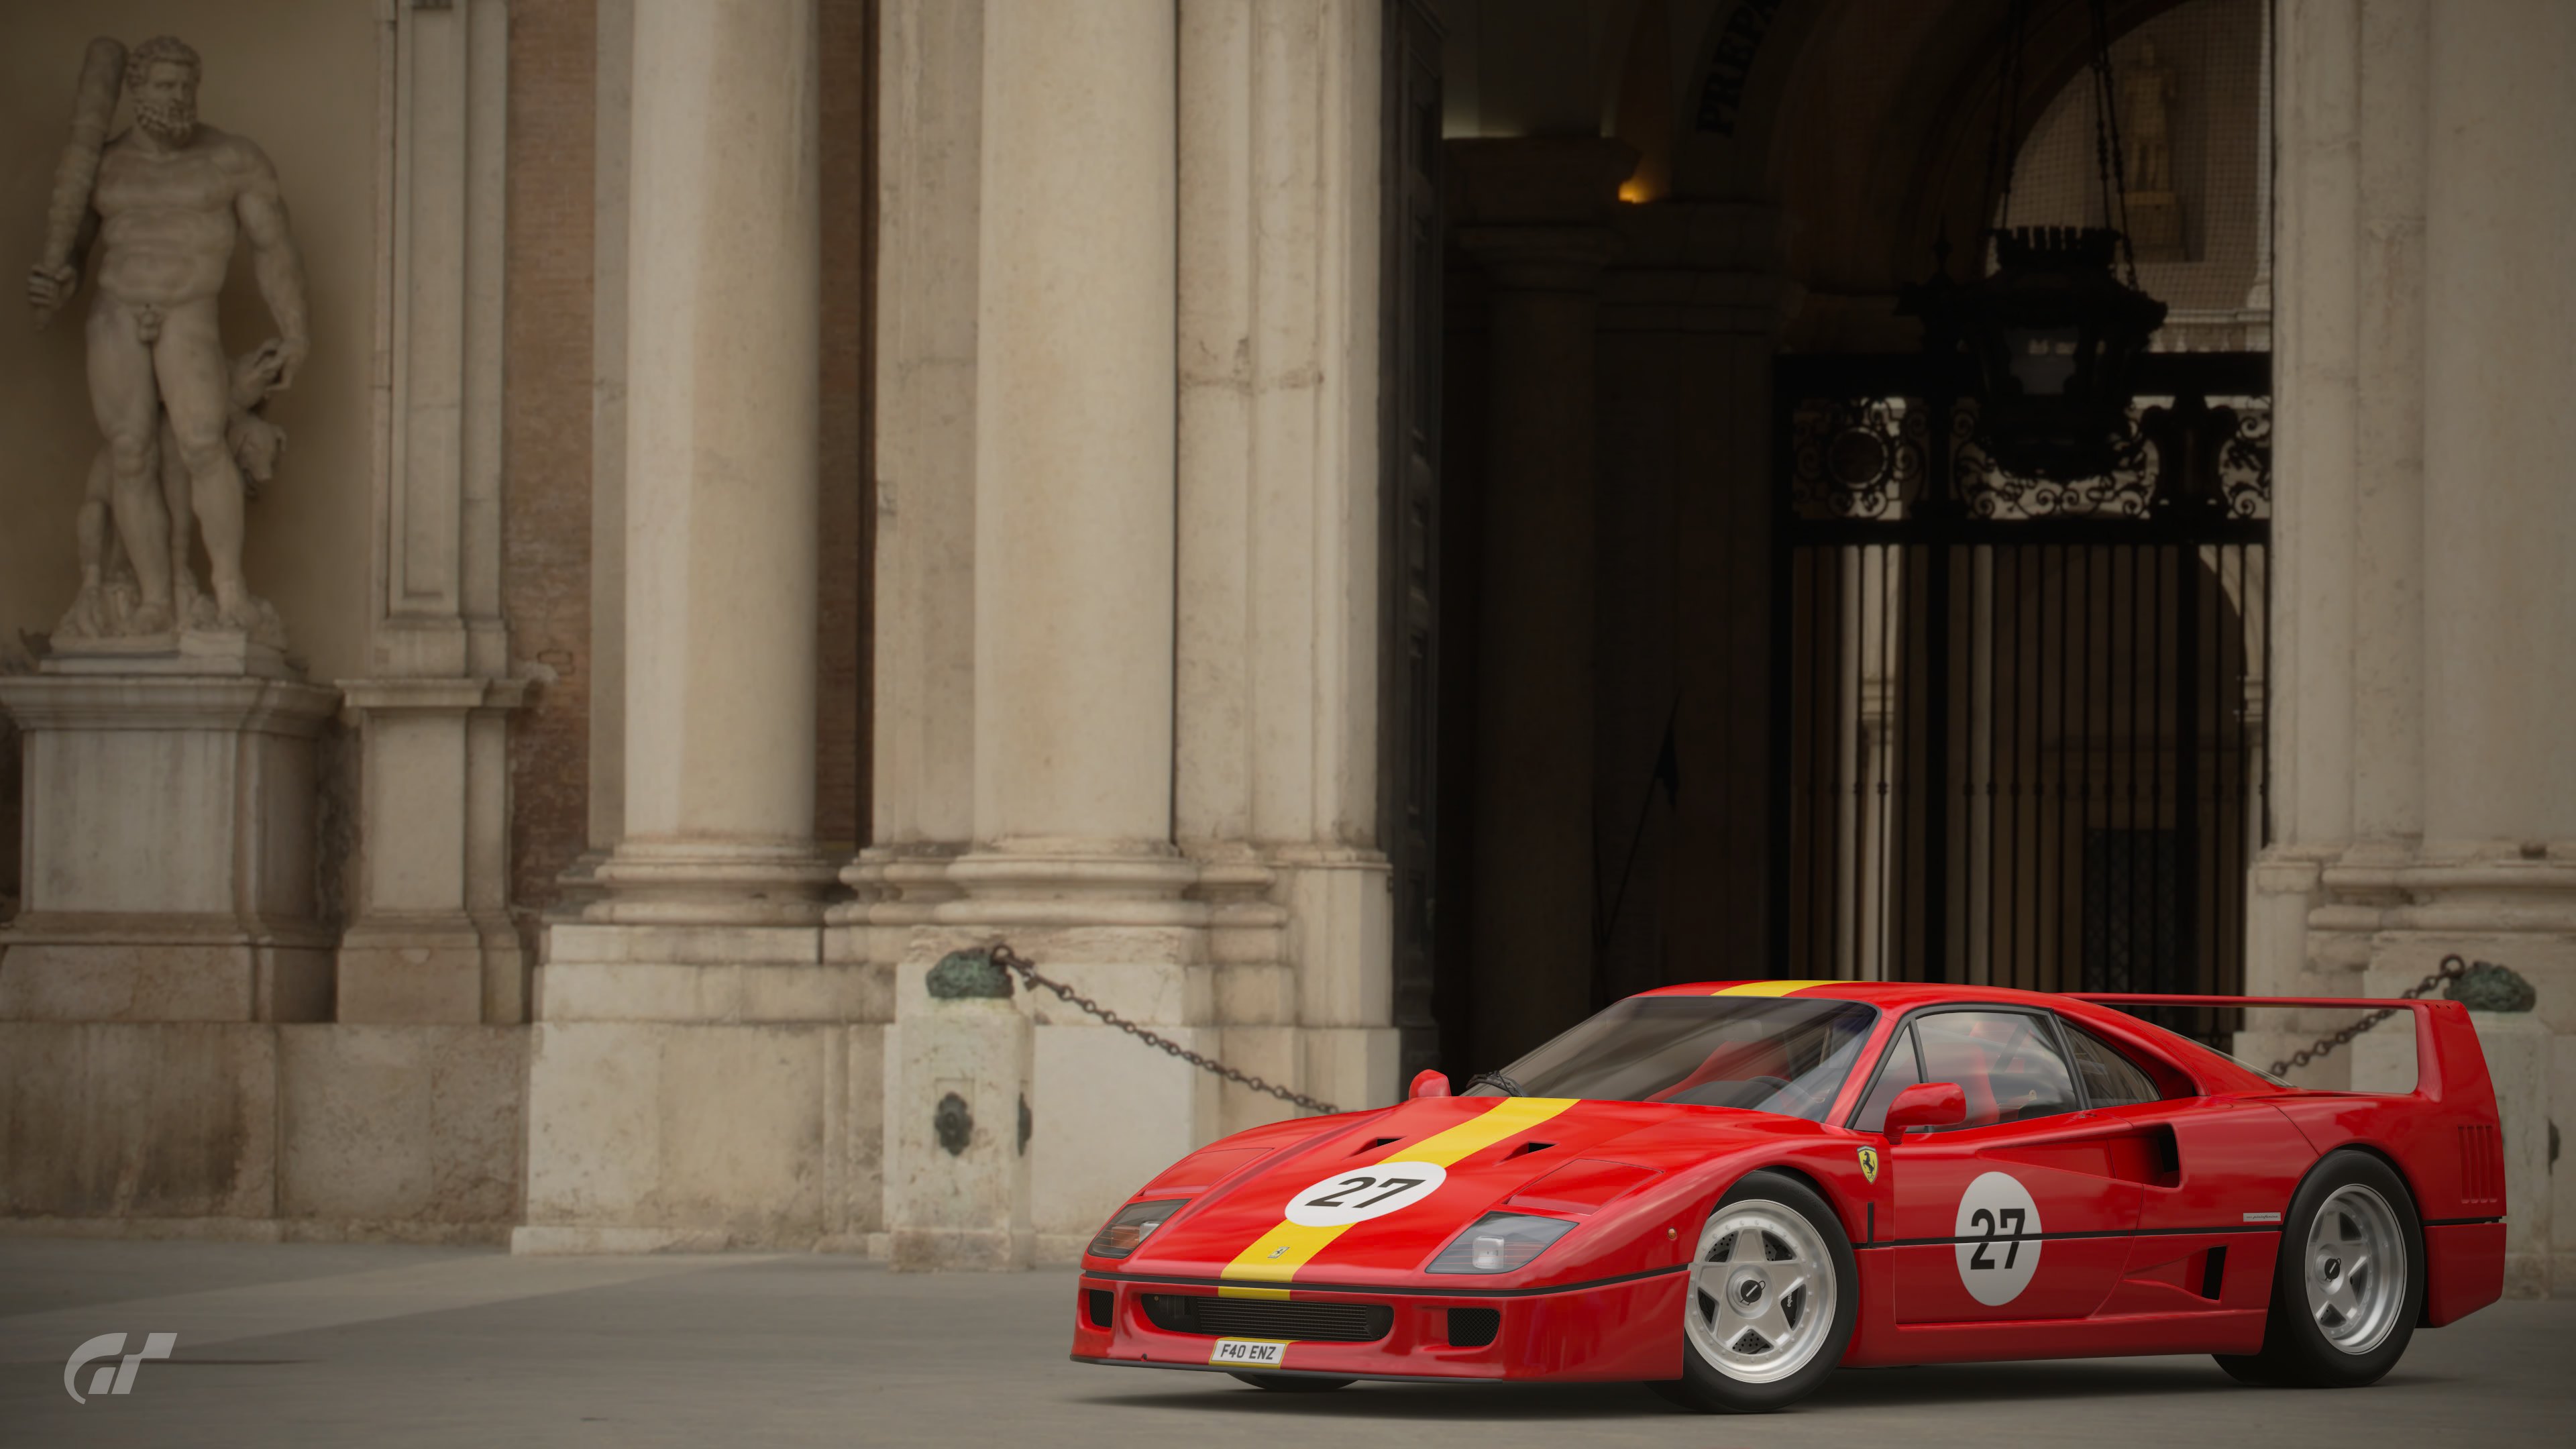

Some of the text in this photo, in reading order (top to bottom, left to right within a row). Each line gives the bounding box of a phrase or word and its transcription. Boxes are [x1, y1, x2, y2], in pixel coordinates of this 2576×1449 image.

[1304, 1177, 1427, 1208] 27
[1970, 1208, 2025, 1270] 27
[1221, 1344, 1276, 1360] F40 ENZ
